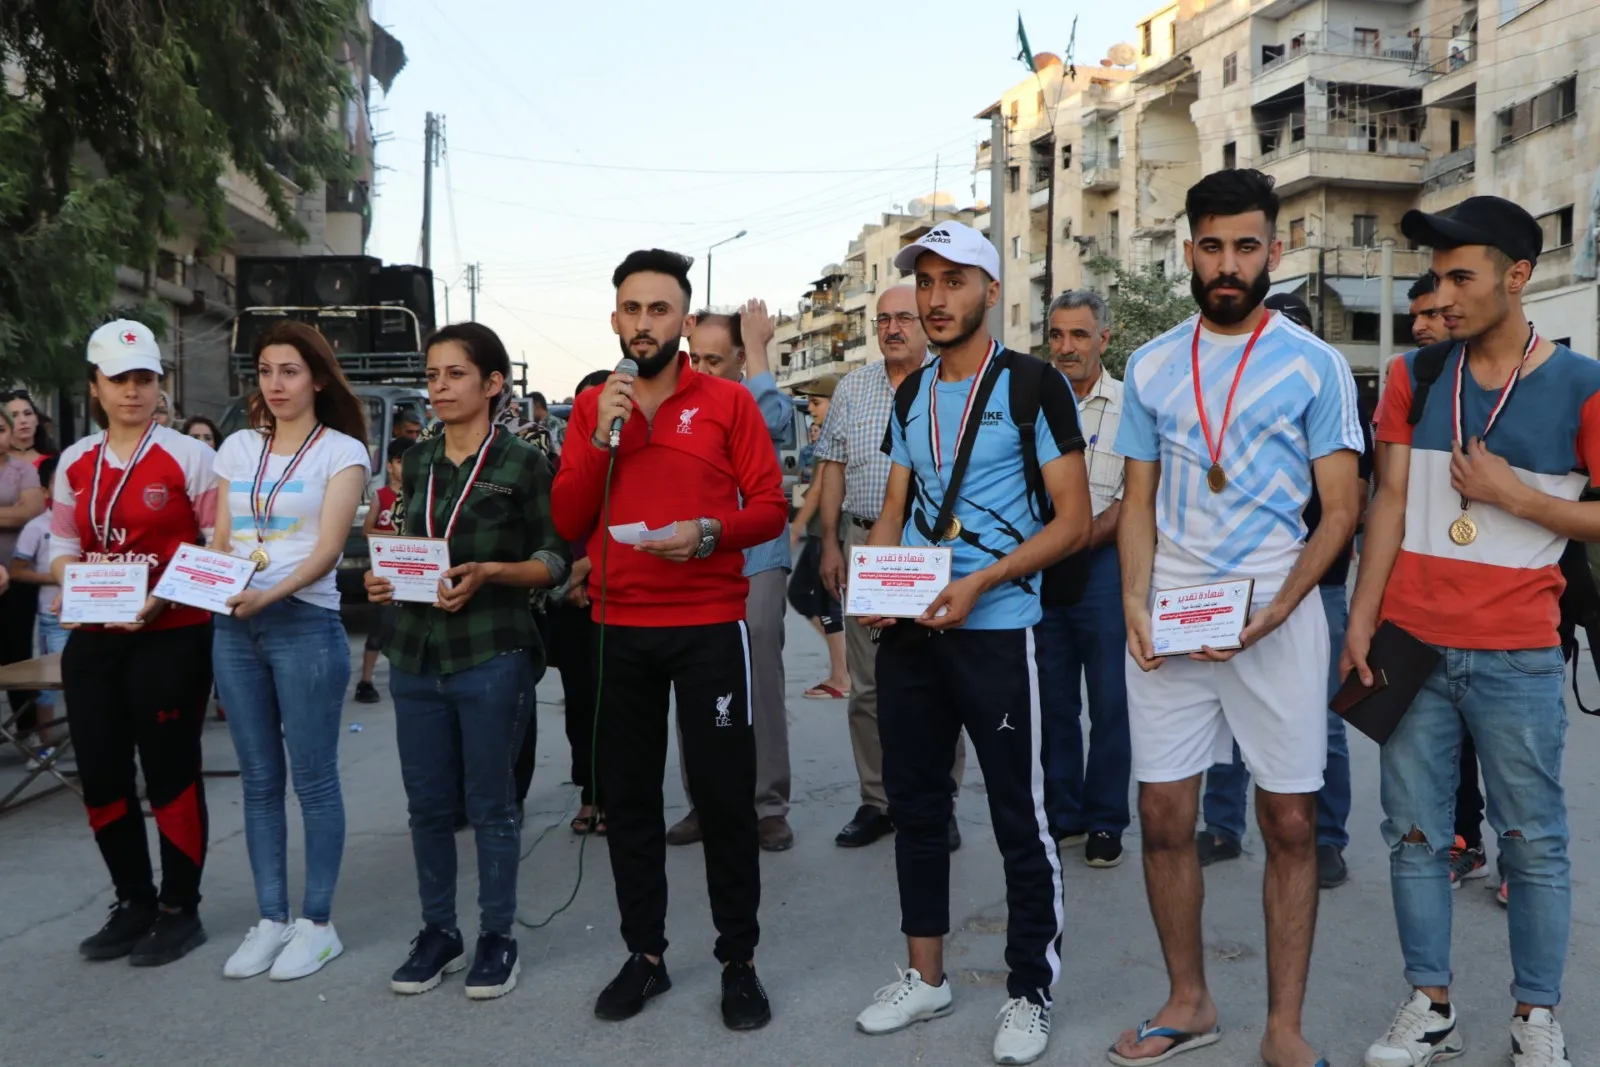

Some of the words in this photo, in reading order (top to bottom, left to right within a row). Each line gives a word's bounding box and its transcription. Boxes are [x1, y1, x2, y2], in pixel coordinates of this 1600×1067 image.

[922, 236, 951, 245] adidas
[983, 411, 1004, 420] IKE
[876, 553, 897, 563] تقدير
[898, 551, 925, 563] شهادة
[1177, 592, 1198, 604] تقدير
[1199, 587, 1225, 599] شهادة
